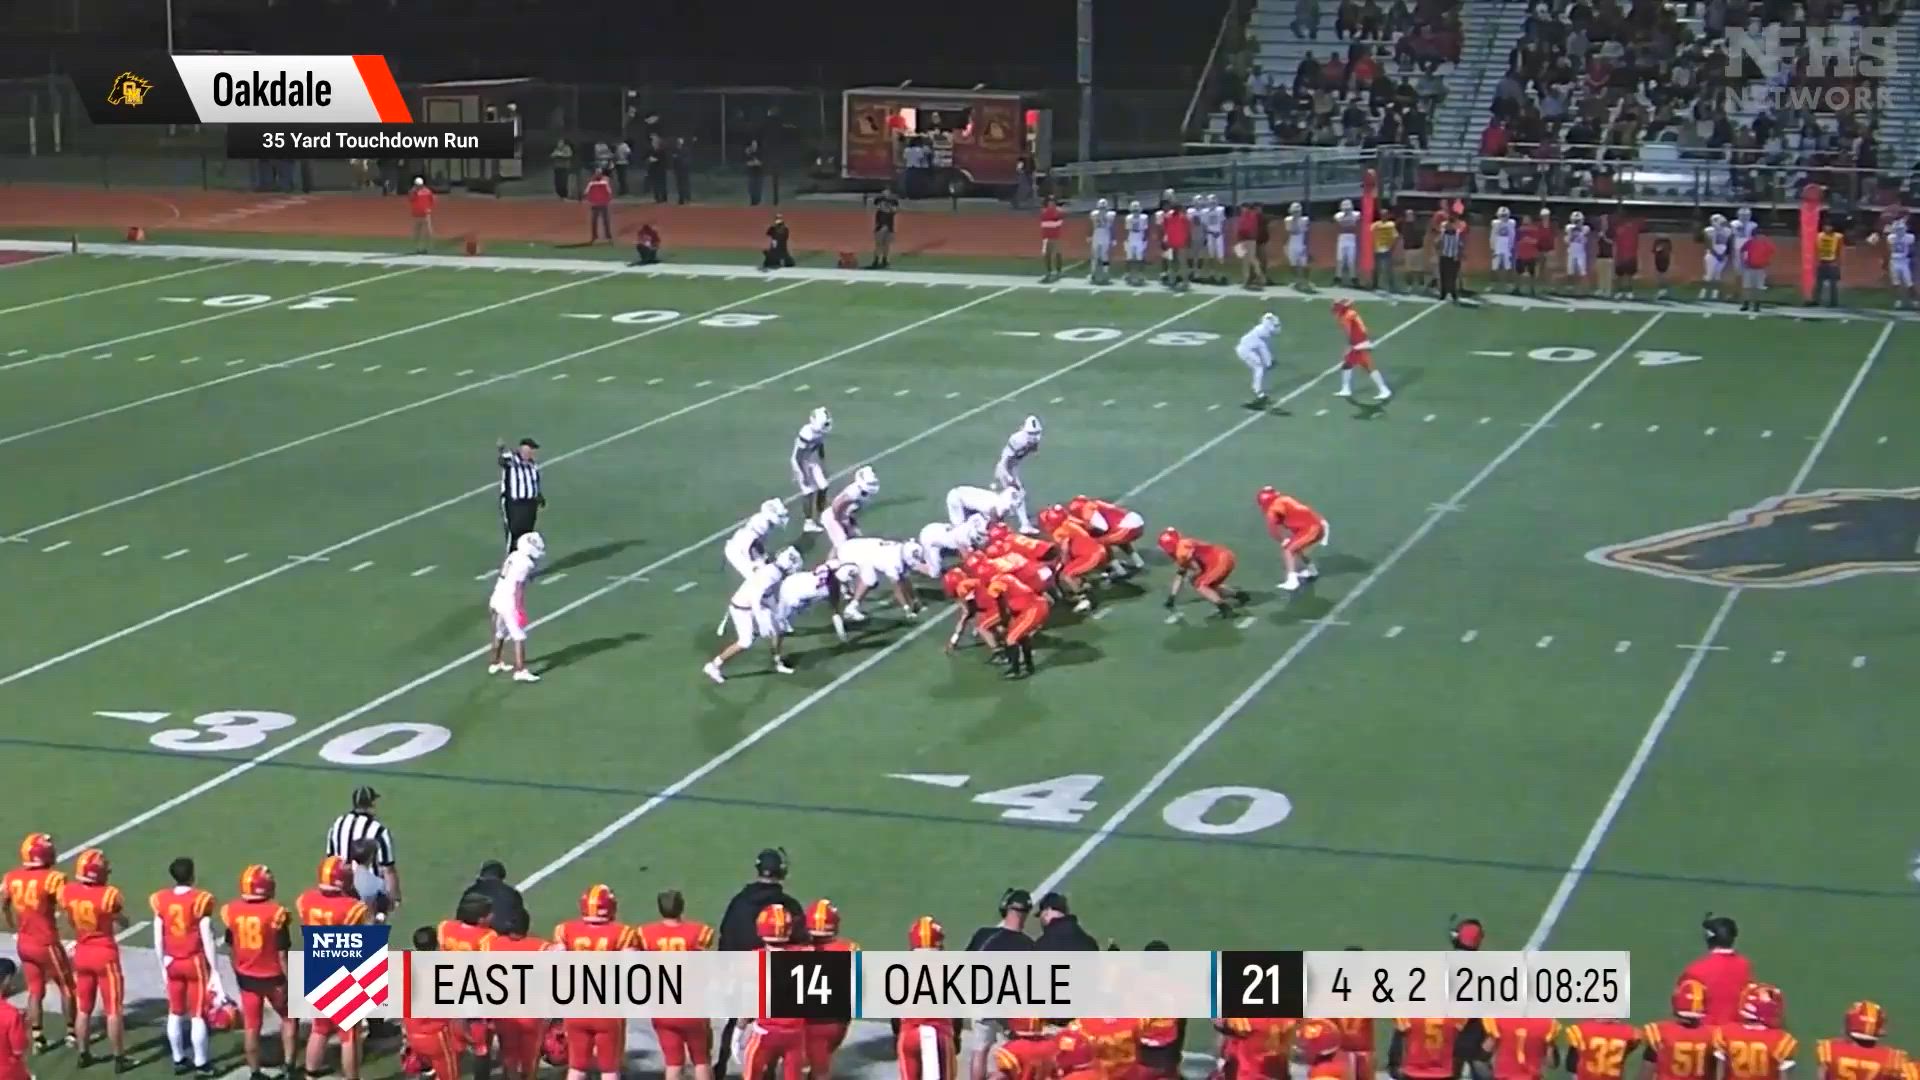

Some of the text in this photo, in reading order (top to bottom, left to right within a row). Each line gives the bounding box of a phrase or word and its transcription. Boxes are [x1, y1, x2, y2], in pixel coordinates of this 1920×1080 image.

[12, 879, 39, 912] 24
[169, 904, 185, 937] 3
[235, 915, 262, 949] 18
[1587, 1036, 1627, 1076] 32
[1672, 1041, 1706, 1076] 51
[1728, 1041, 1769, 1076] 20
